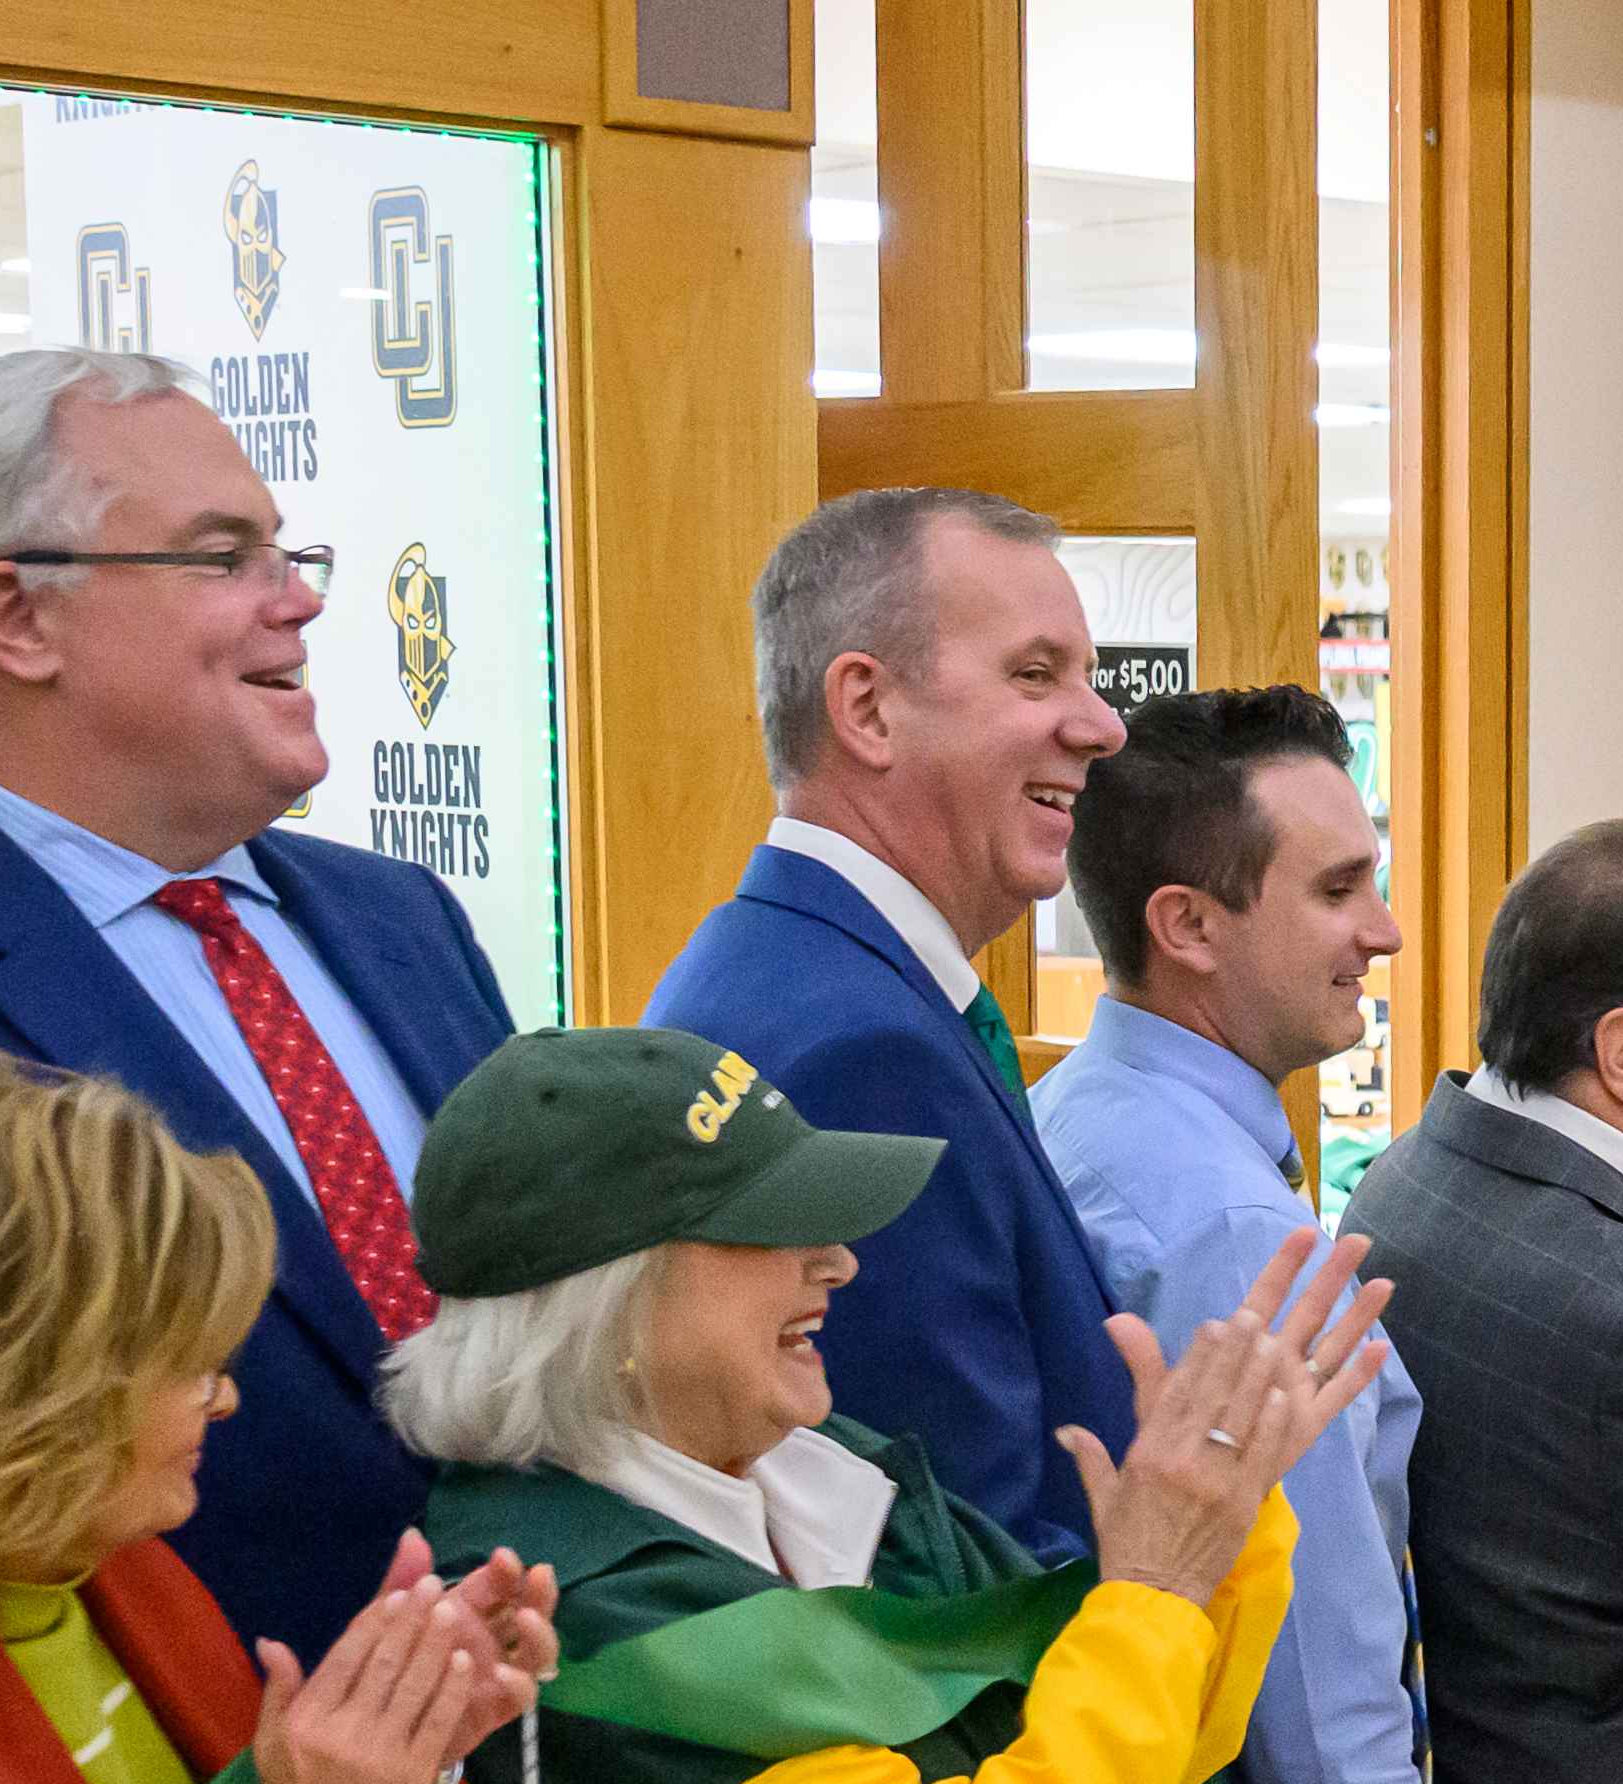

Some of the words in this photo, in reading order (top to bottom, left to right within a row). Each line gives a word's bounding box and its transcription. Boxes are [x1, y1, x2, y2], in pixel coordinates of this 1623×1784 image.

[211, 352, 310, 417] GOLDEN
[235, 418, 318, 482] IGHTS
[1119, 659, 1183, 704] $5.00
[373, 740, 481, 808] GOLDEN
[370, 808, 490, 879] KNIGHTS
